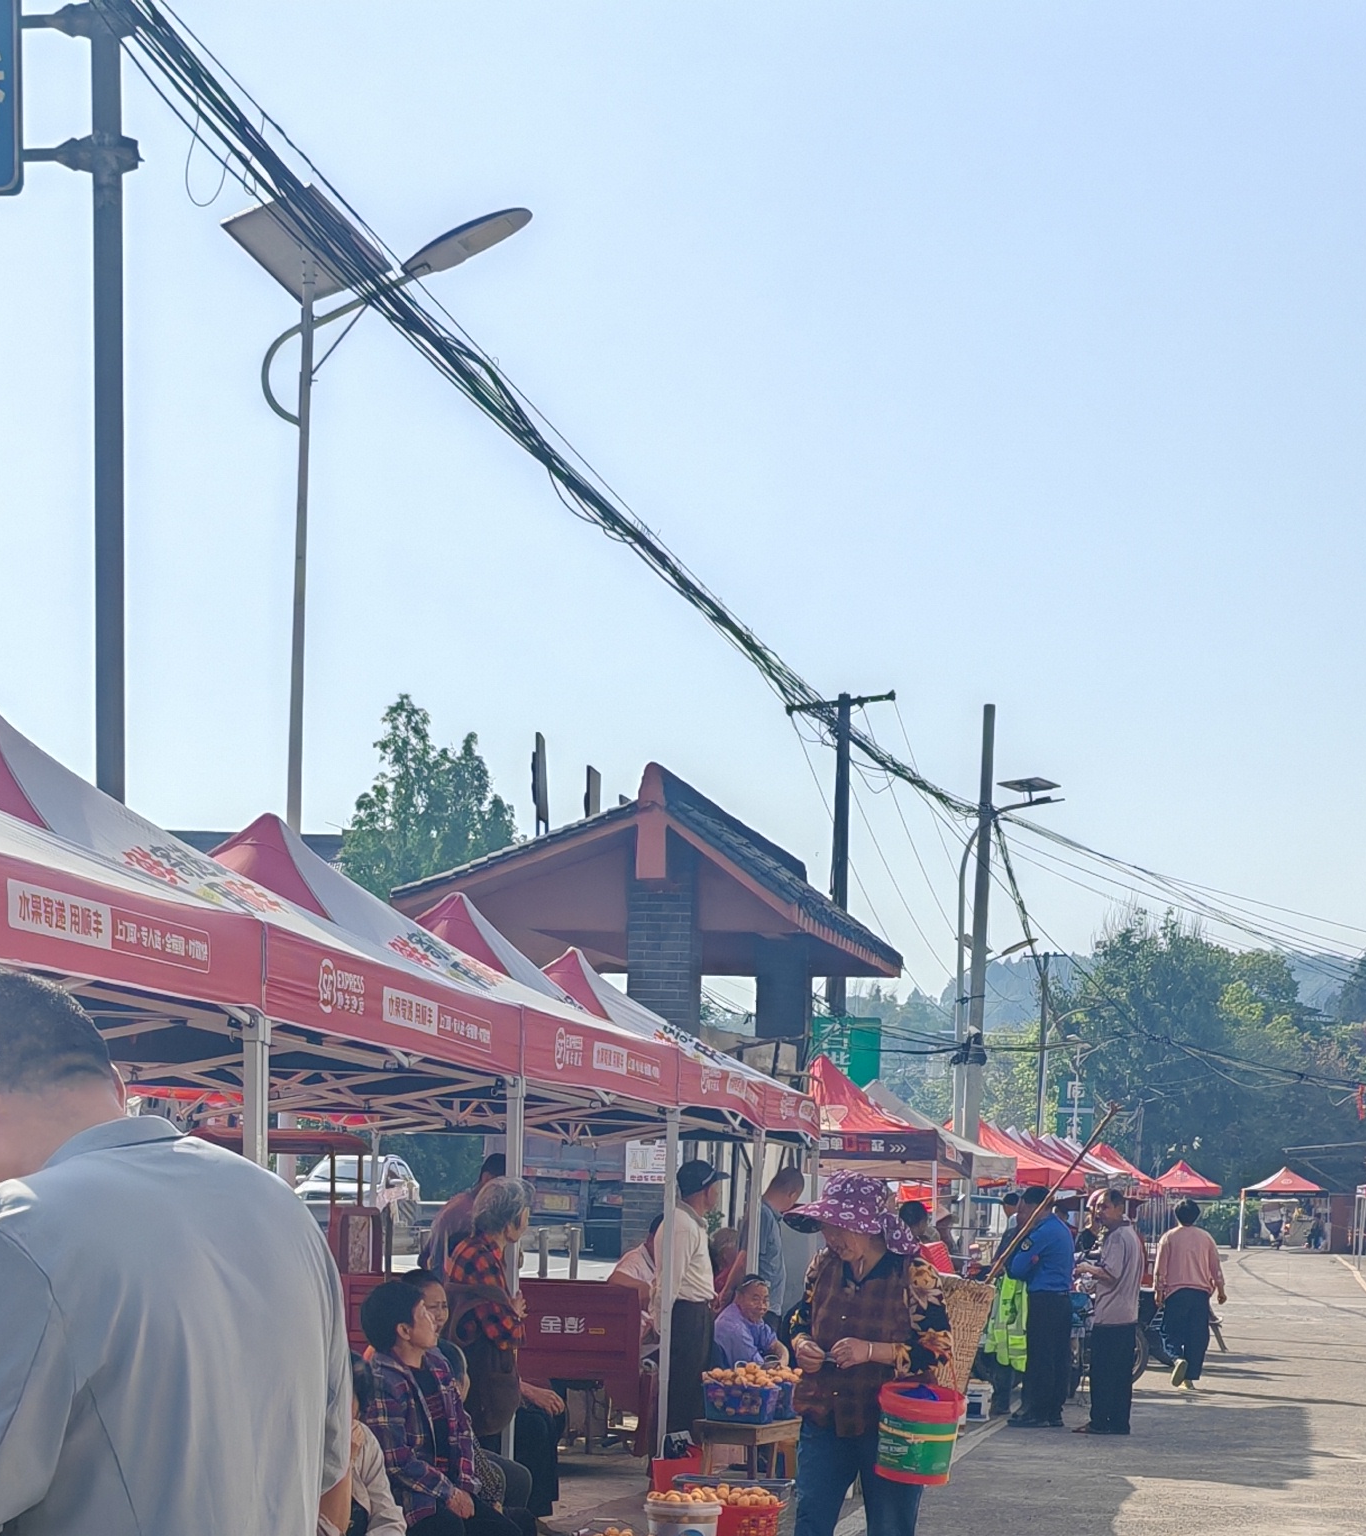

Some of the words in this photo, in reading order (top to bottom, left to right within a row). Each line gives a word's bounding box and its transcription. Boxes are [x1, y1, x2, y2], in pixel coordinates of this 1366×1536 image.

[18, 890, 67, 932] 水果寄递
[68, 902, 105, 939] 用顺丰
[335, 968, 366, 996] EXPRESS
[539, 1315, 586, 1334] 金彭
